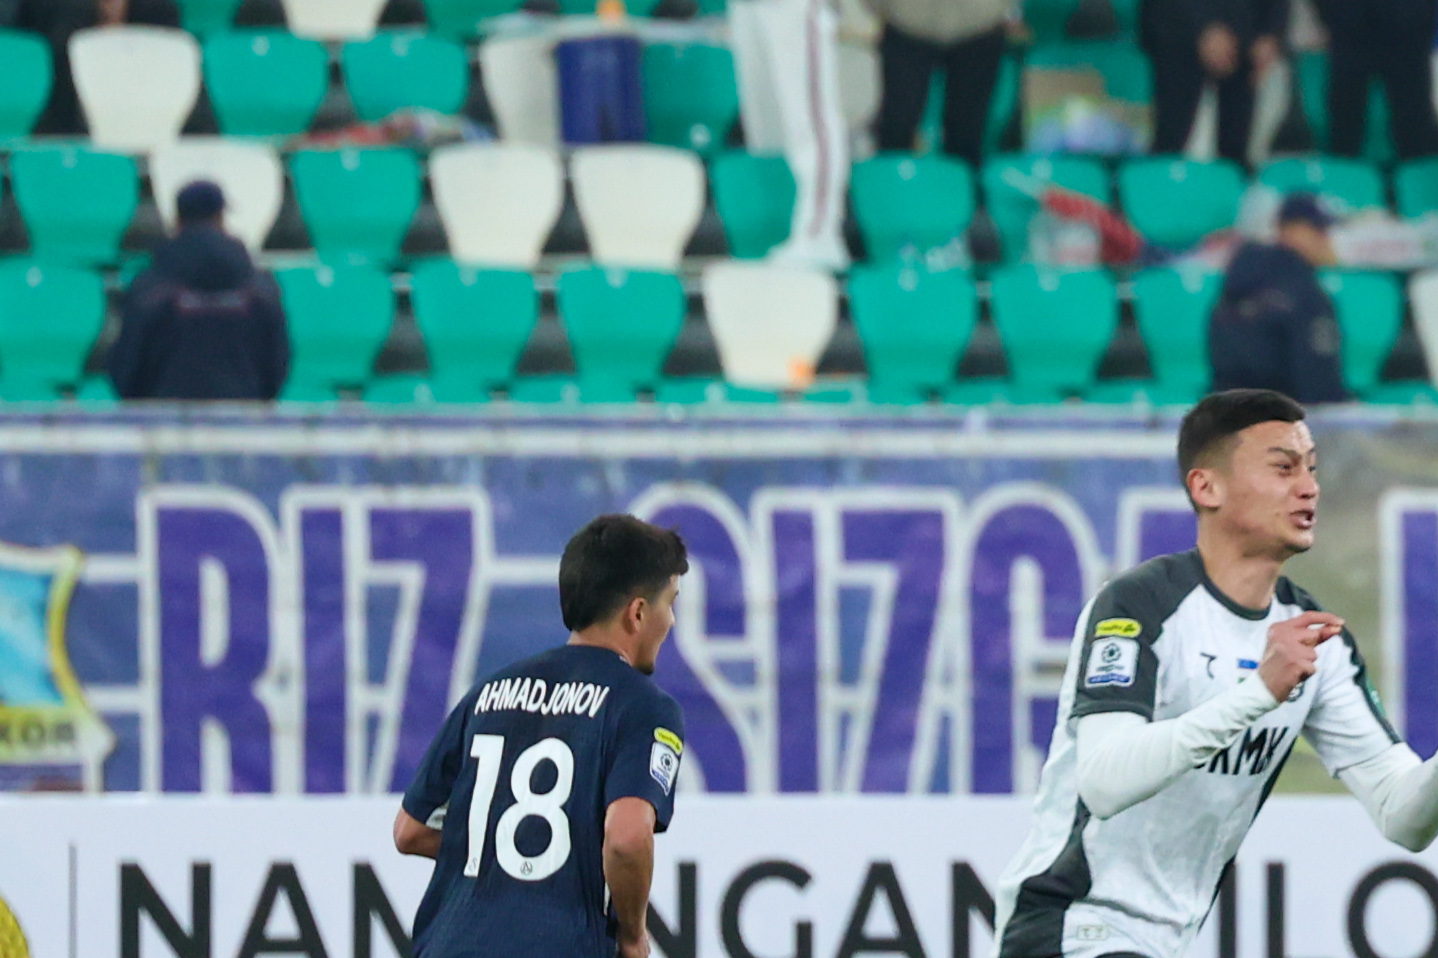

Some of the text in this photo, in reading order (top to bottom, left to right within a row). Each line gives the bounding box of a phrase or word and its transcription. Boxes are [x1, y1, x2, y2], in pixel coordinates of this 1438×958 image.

[475, 677, 610, 718] AHMADJONOV
[627, 484, 1200, 793] SIZG
[464, 734, 574, 882] 18
